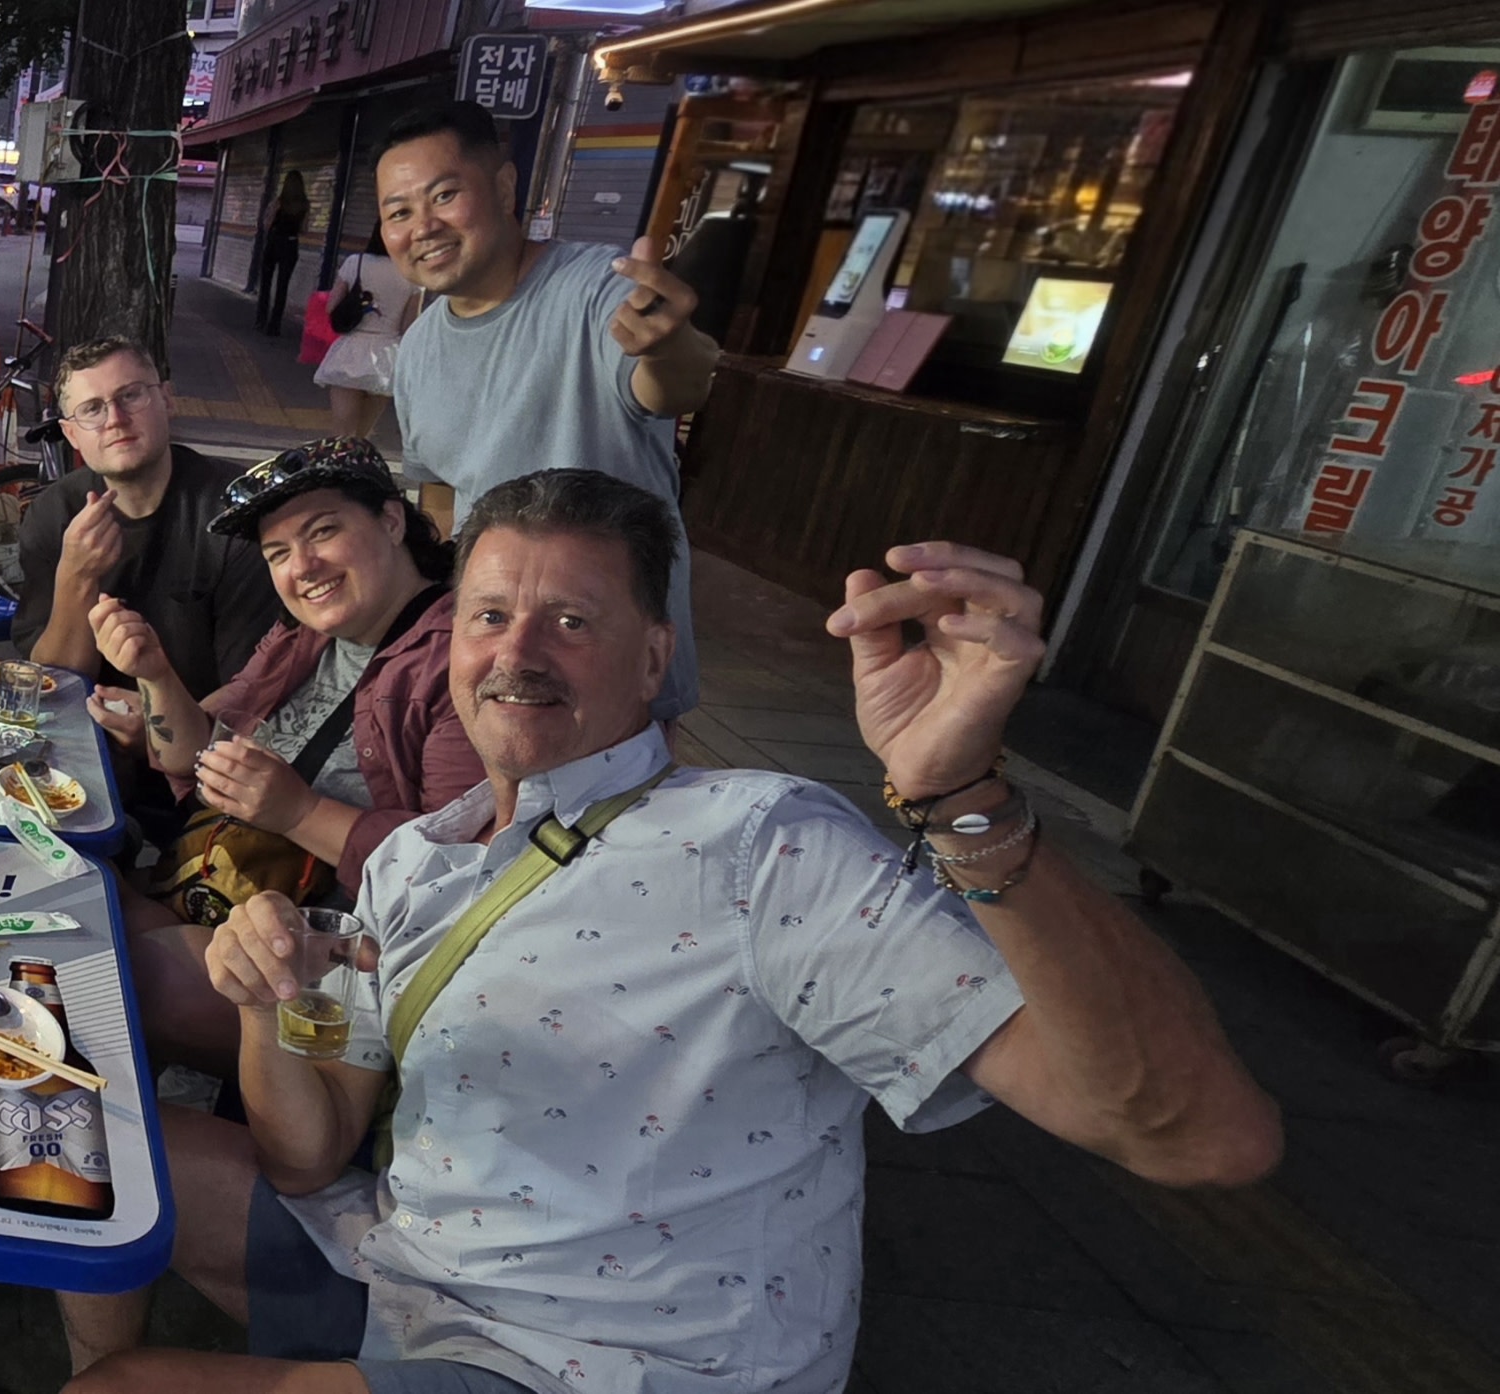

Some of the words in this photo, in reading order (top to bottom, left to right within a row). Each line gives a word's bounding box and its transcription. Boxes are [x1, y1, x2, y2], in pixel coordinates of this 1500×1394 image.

[478, 44, 536, 76] 전자
[475, 77, 529, 110] 담배
[22, 1133, 64, 1144] FRESH
[29, 1142, 62, 1158] 0.0
